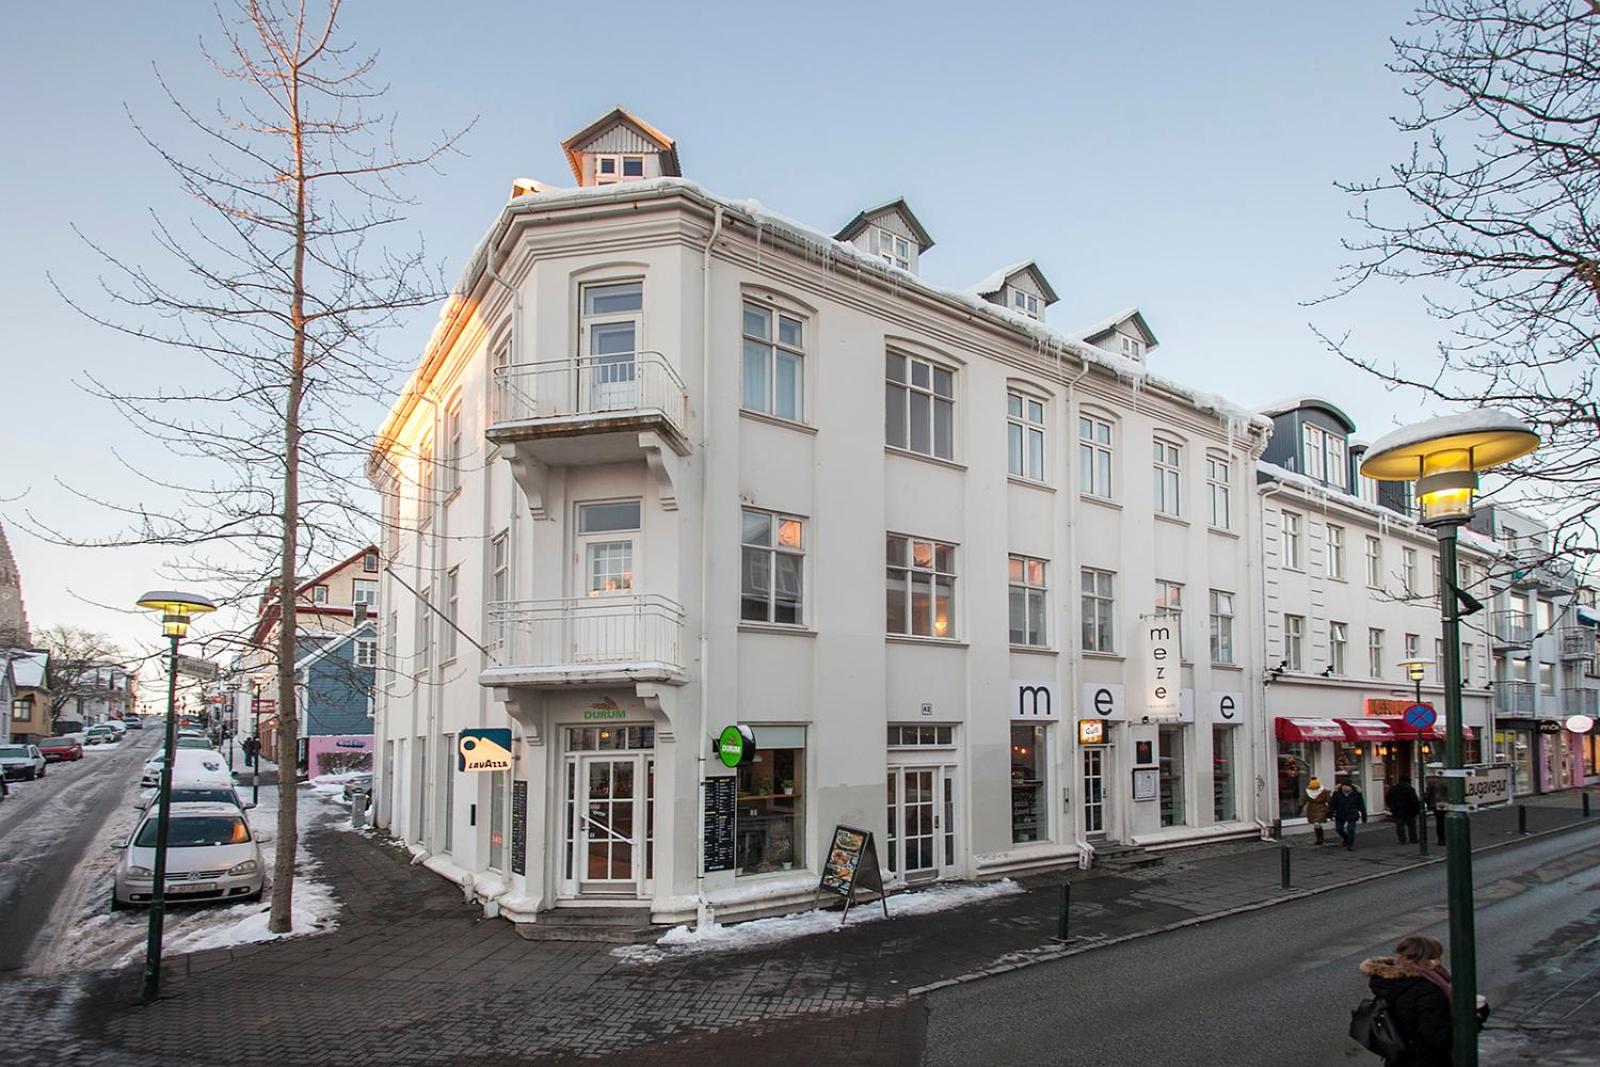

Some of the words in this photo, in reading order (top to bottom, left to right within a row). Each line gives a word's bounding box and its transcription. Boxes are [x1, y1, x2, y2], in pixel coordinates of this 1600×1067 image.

[584, 710, 626, 720] DURUM
[468, 760, 508, 769] LAVAZZA
[1464, 779, 1507, 799] augavegur
